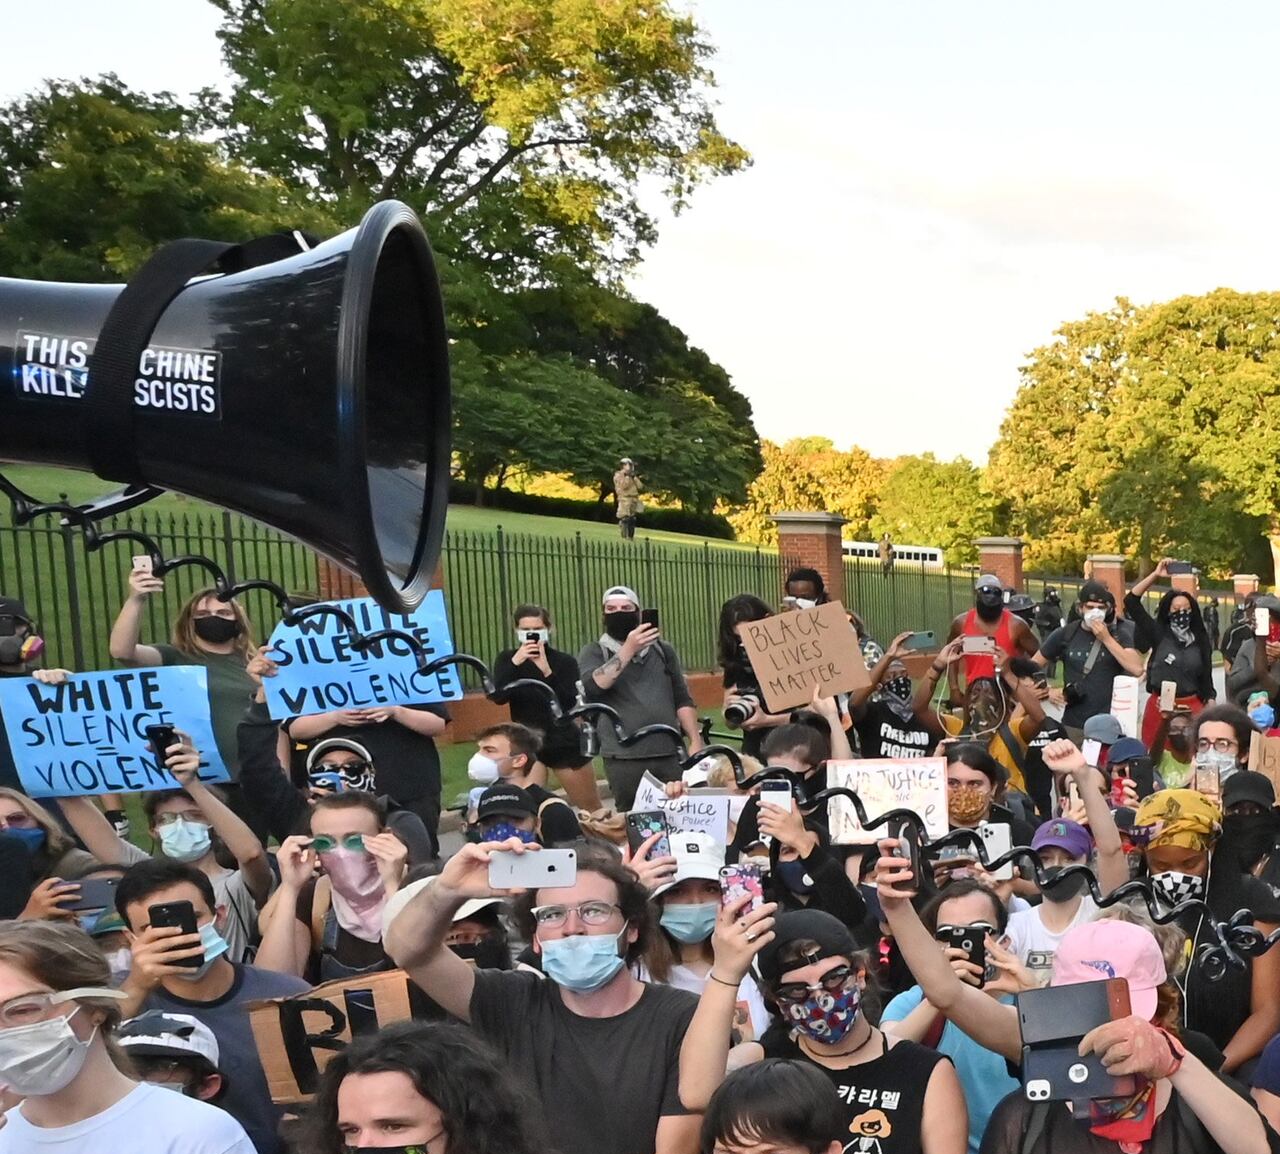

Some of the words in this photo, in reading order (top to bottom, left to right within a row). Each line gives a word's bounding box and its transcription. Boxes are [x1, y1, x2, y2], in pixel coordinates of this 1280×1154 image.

[24, 335, 88, 368] THIS
[139, 349, 216, 383] CHINE
[134, 378, 215, 413] SCISTS
[296, 602, 419, 635] WHITE
[748, 611, 829, 653] BLACK
[273, 628, 436, 666] SILENCE
[769, 639, 824, 671] LIVES
[26, 671, 163, 714] WHITE
[279, 667, 456, 715] VIOLENCE
[768, 661, 841, 697] MATTER
[880, 722, 929, 746] FREEDOM
[35, 750, 220, 791] VIOLENE
